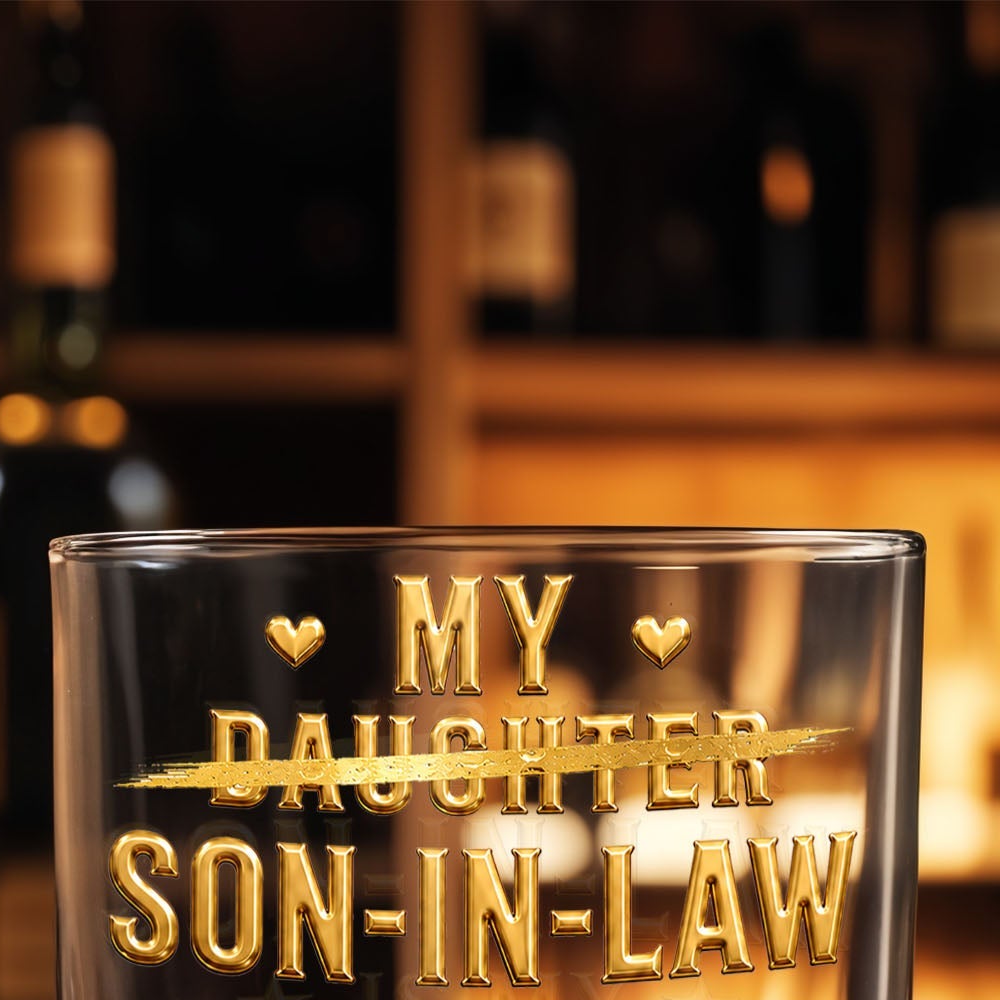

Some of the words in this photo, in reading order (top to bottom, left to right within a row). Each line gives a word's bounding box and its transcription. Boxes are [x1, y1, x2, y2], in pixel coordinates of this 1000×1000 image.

[393, 573, 575, 697] MY
[207, 708, 774, 817] DAUGHTER
[107, 830, 858, 988] SON-IN-LAW
